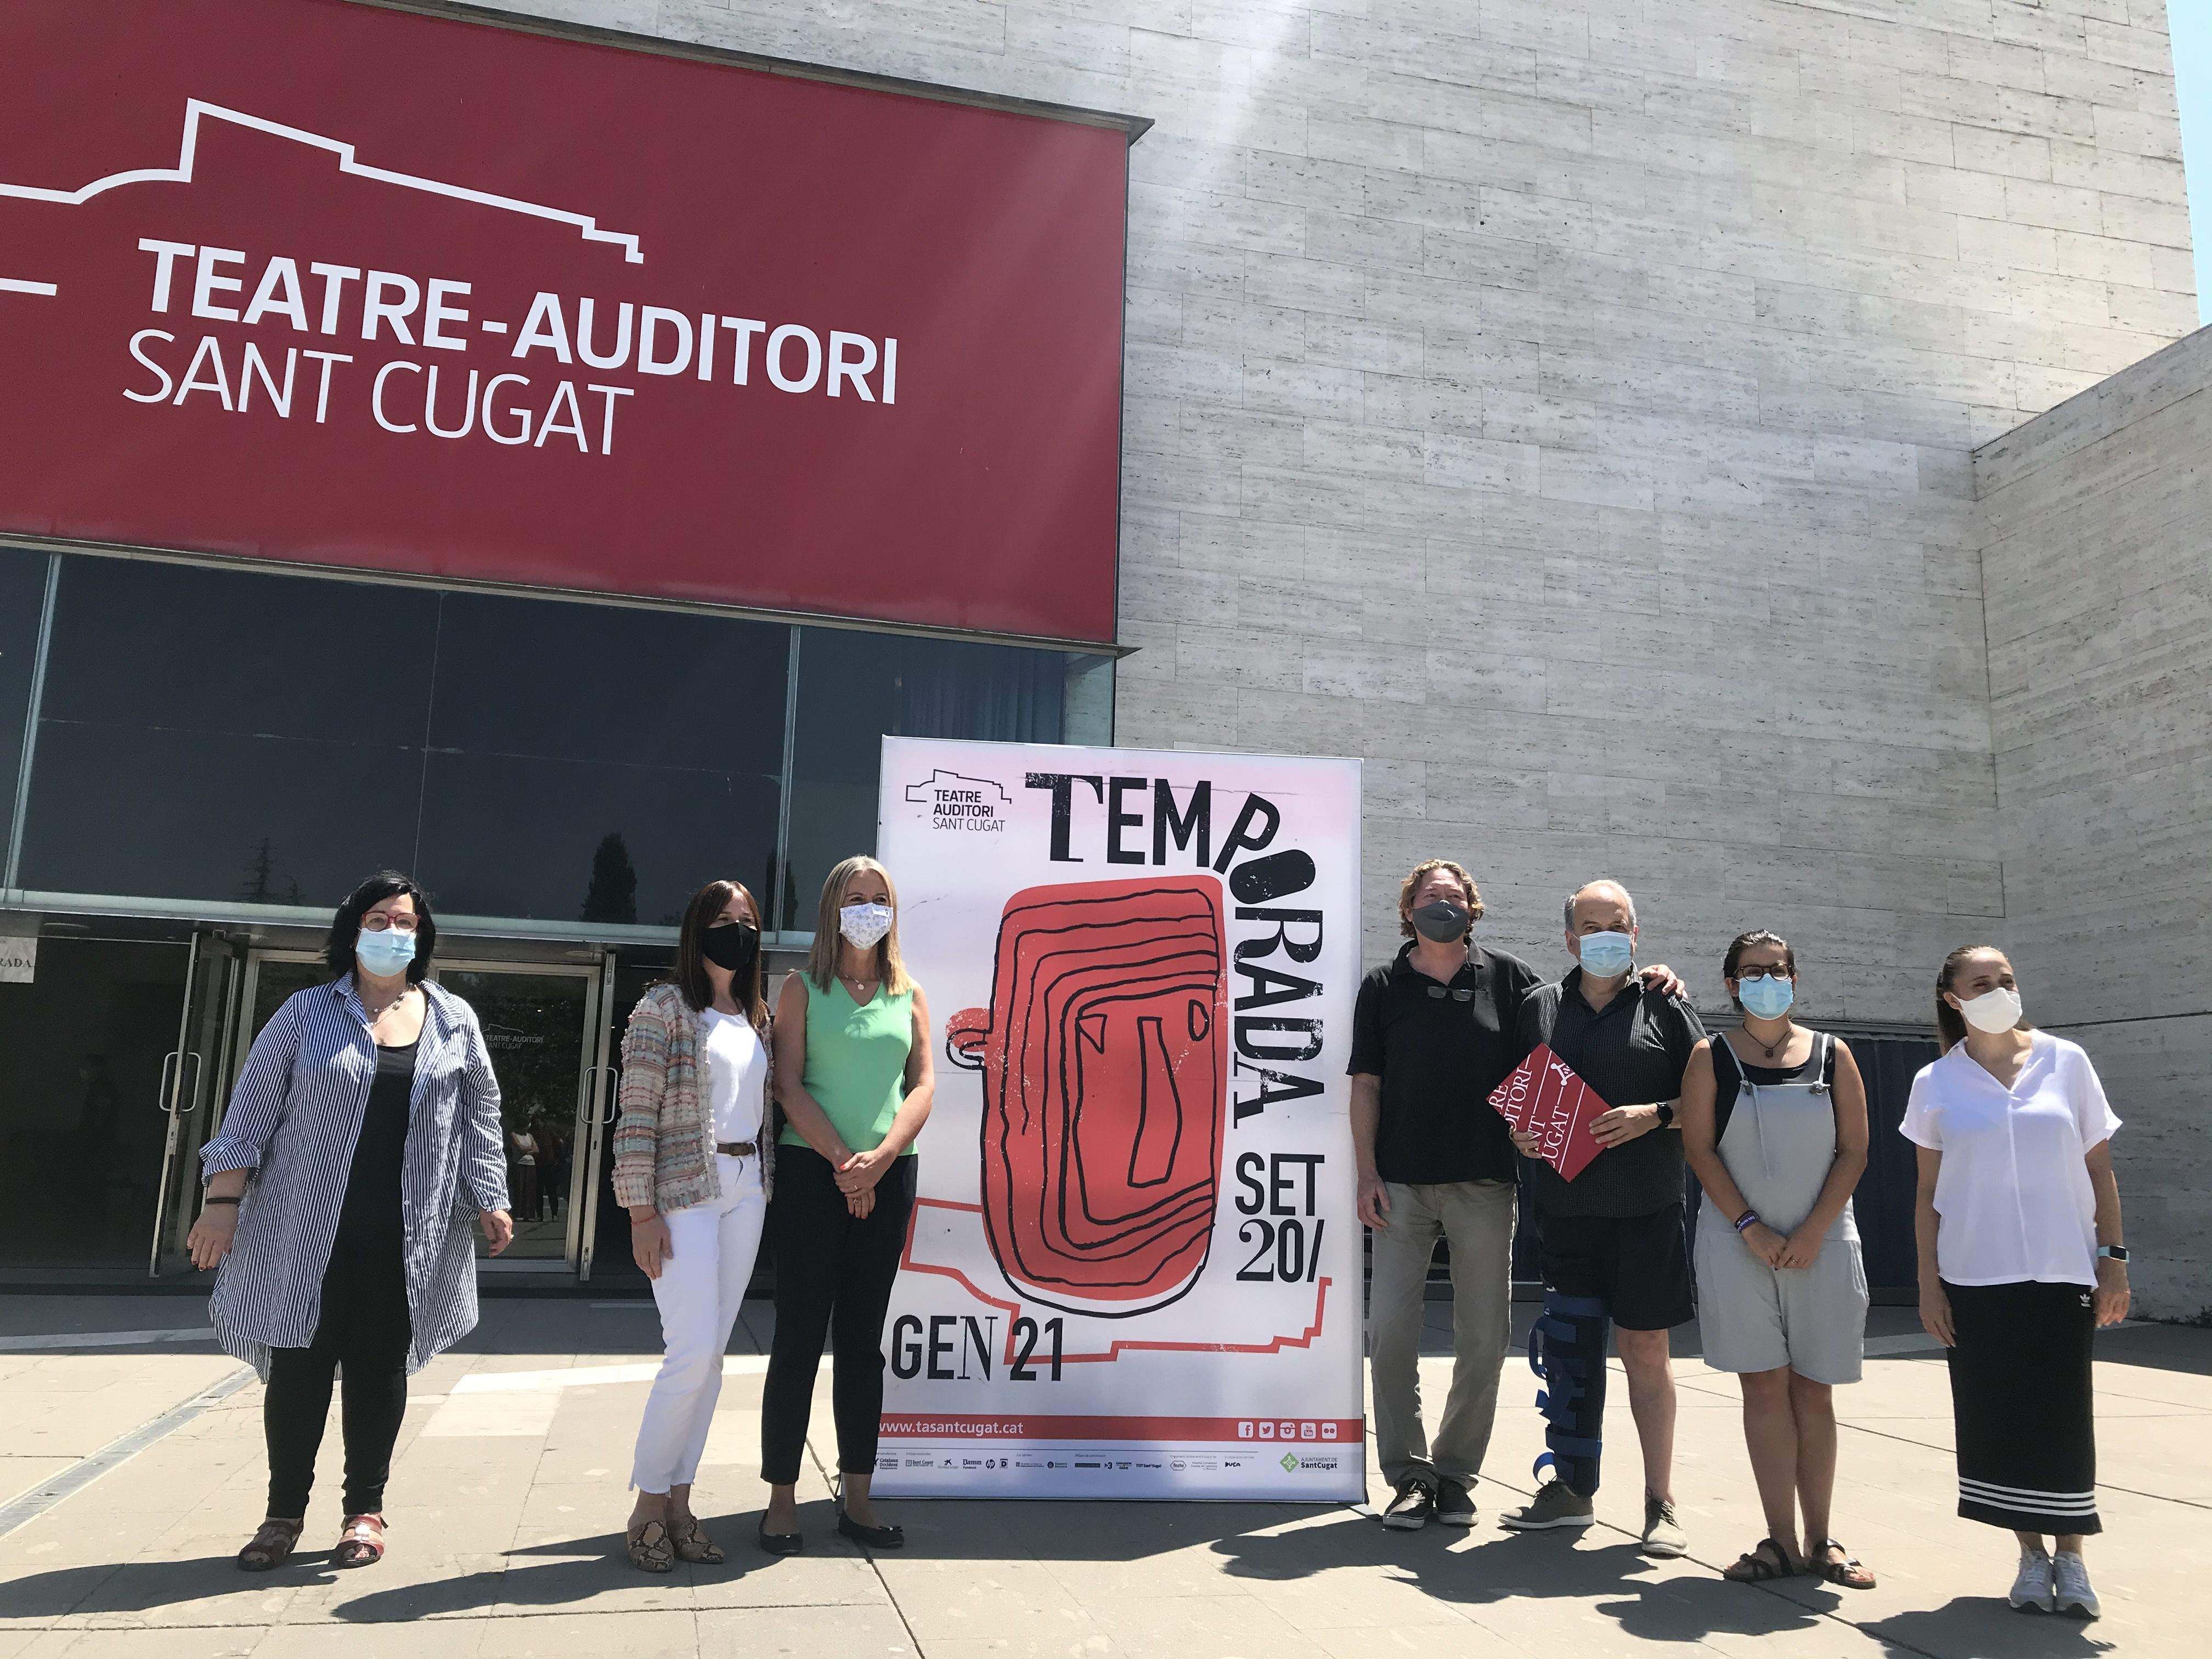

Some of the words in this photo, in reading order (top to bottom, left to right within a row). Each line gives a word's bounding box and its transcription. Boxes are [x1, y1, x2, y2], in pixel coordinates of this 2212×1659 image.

[138, 238, 898, 405] TEATRE-AUDITORI
[123, 329, 354, 424] SANT
[373, 360, 635, 455] CUGAT
[933, 803, 994, 817] AUDITORI
[934, 789, 981, 803] TEATRE
[933, 817, 964, 830] SANT
[967, 819, 1006, 832] CUGAT
[1025, 772, 1324, 1129] TEMPORADA
[486, 1035, 543, 1043] TEATRE-AUDITORI
[1488, 1085, 1509, 1115] RE
[1542, 1105, 1570, 1169] UGAT
[1235, 1152, 1325, 1217] SET
[891, 1314, 998, 1381] GEN
[1009, 1317, 1063, 1381] 21
[1301, 1462, 1338, 1470] SantCugat
